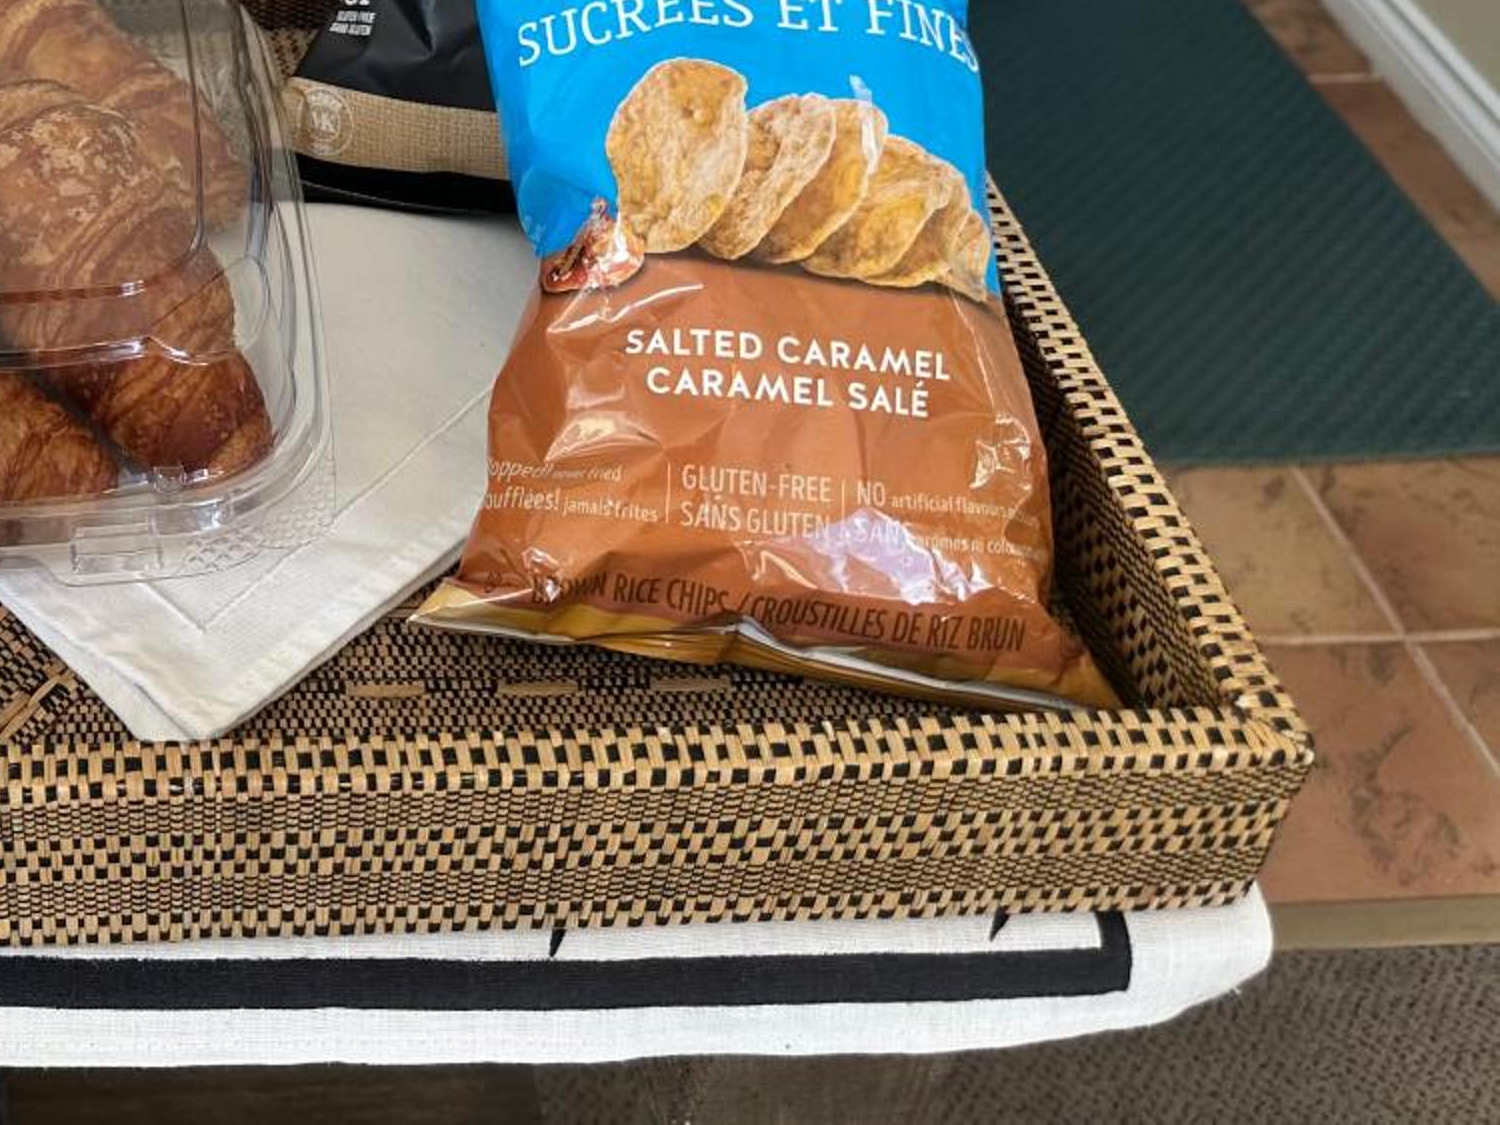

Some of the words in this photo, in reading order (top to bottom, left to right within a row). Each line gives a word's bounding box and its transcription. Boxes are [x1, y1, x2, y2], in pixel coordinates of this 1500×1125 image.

[624, 327, 764, 363] SALTED
[775, 336, 951, 382] CARAMEL
[645, 366, 833, 408] CARAMEL
[847, 373, 930, 419] SALÉ
[484, 487, 561, 513] oufflées!
[681, 463, 833, 503] GLUTEN-FREE
[857, 481, 886, 508] NO
[680, 500, 742, 533] SANS
[746, 506, 831, 541] GLUTEN
[612, 573, 661, 604] RICE
[666, 577, 729, 616] CHIPS
[751, 592, 891, 641] CROUSTILLES
[891, 615, 923, 645] DE
[927, 614, 960, 649] RIZ
[965, 618, 1026, 652] BRUN
